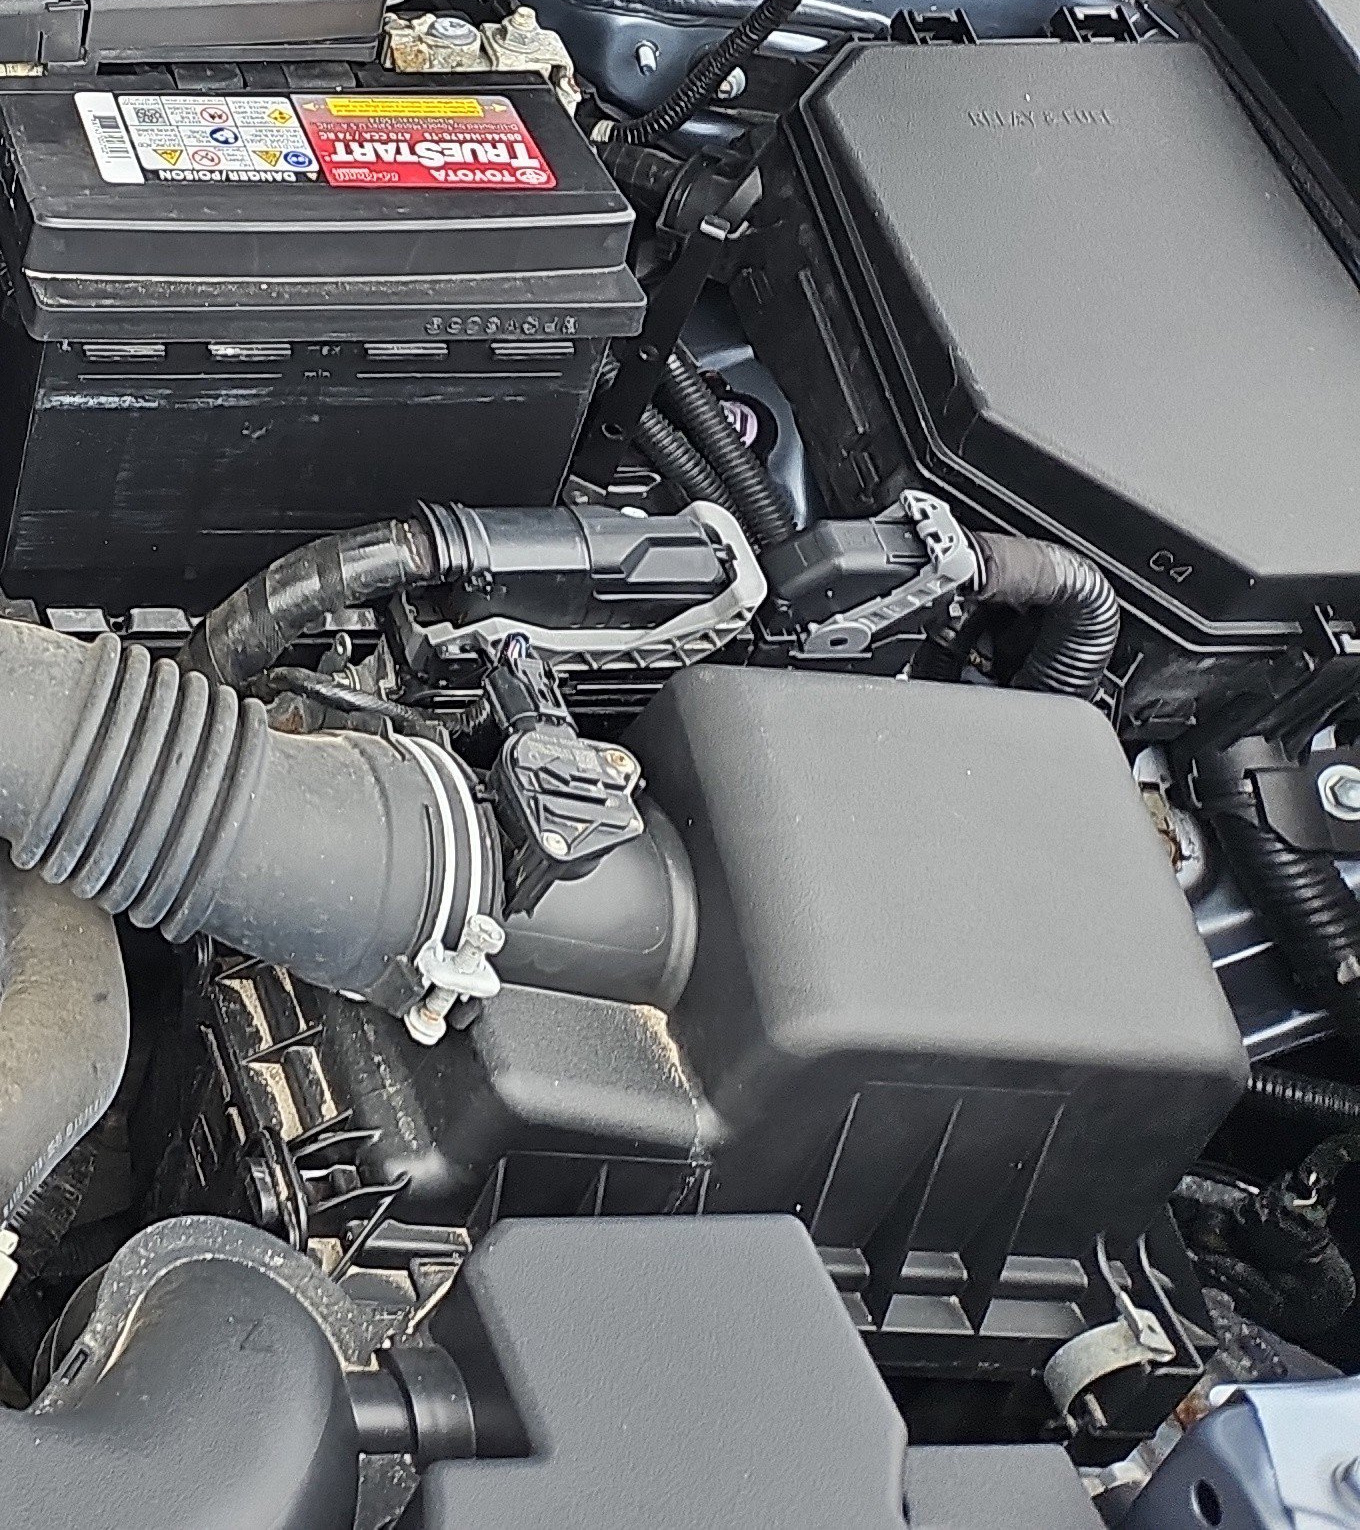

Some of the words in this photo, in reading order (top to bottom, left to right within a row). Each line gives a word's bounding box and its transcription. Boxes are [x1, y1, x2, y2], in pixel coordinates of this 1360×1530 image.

[361, 131, 388, 140] CCA
[390, 131, 411, 140] 470
[158, 169, 297, 182] DANGER/POISON
[429, 169, 516, 183] TOYOTA
